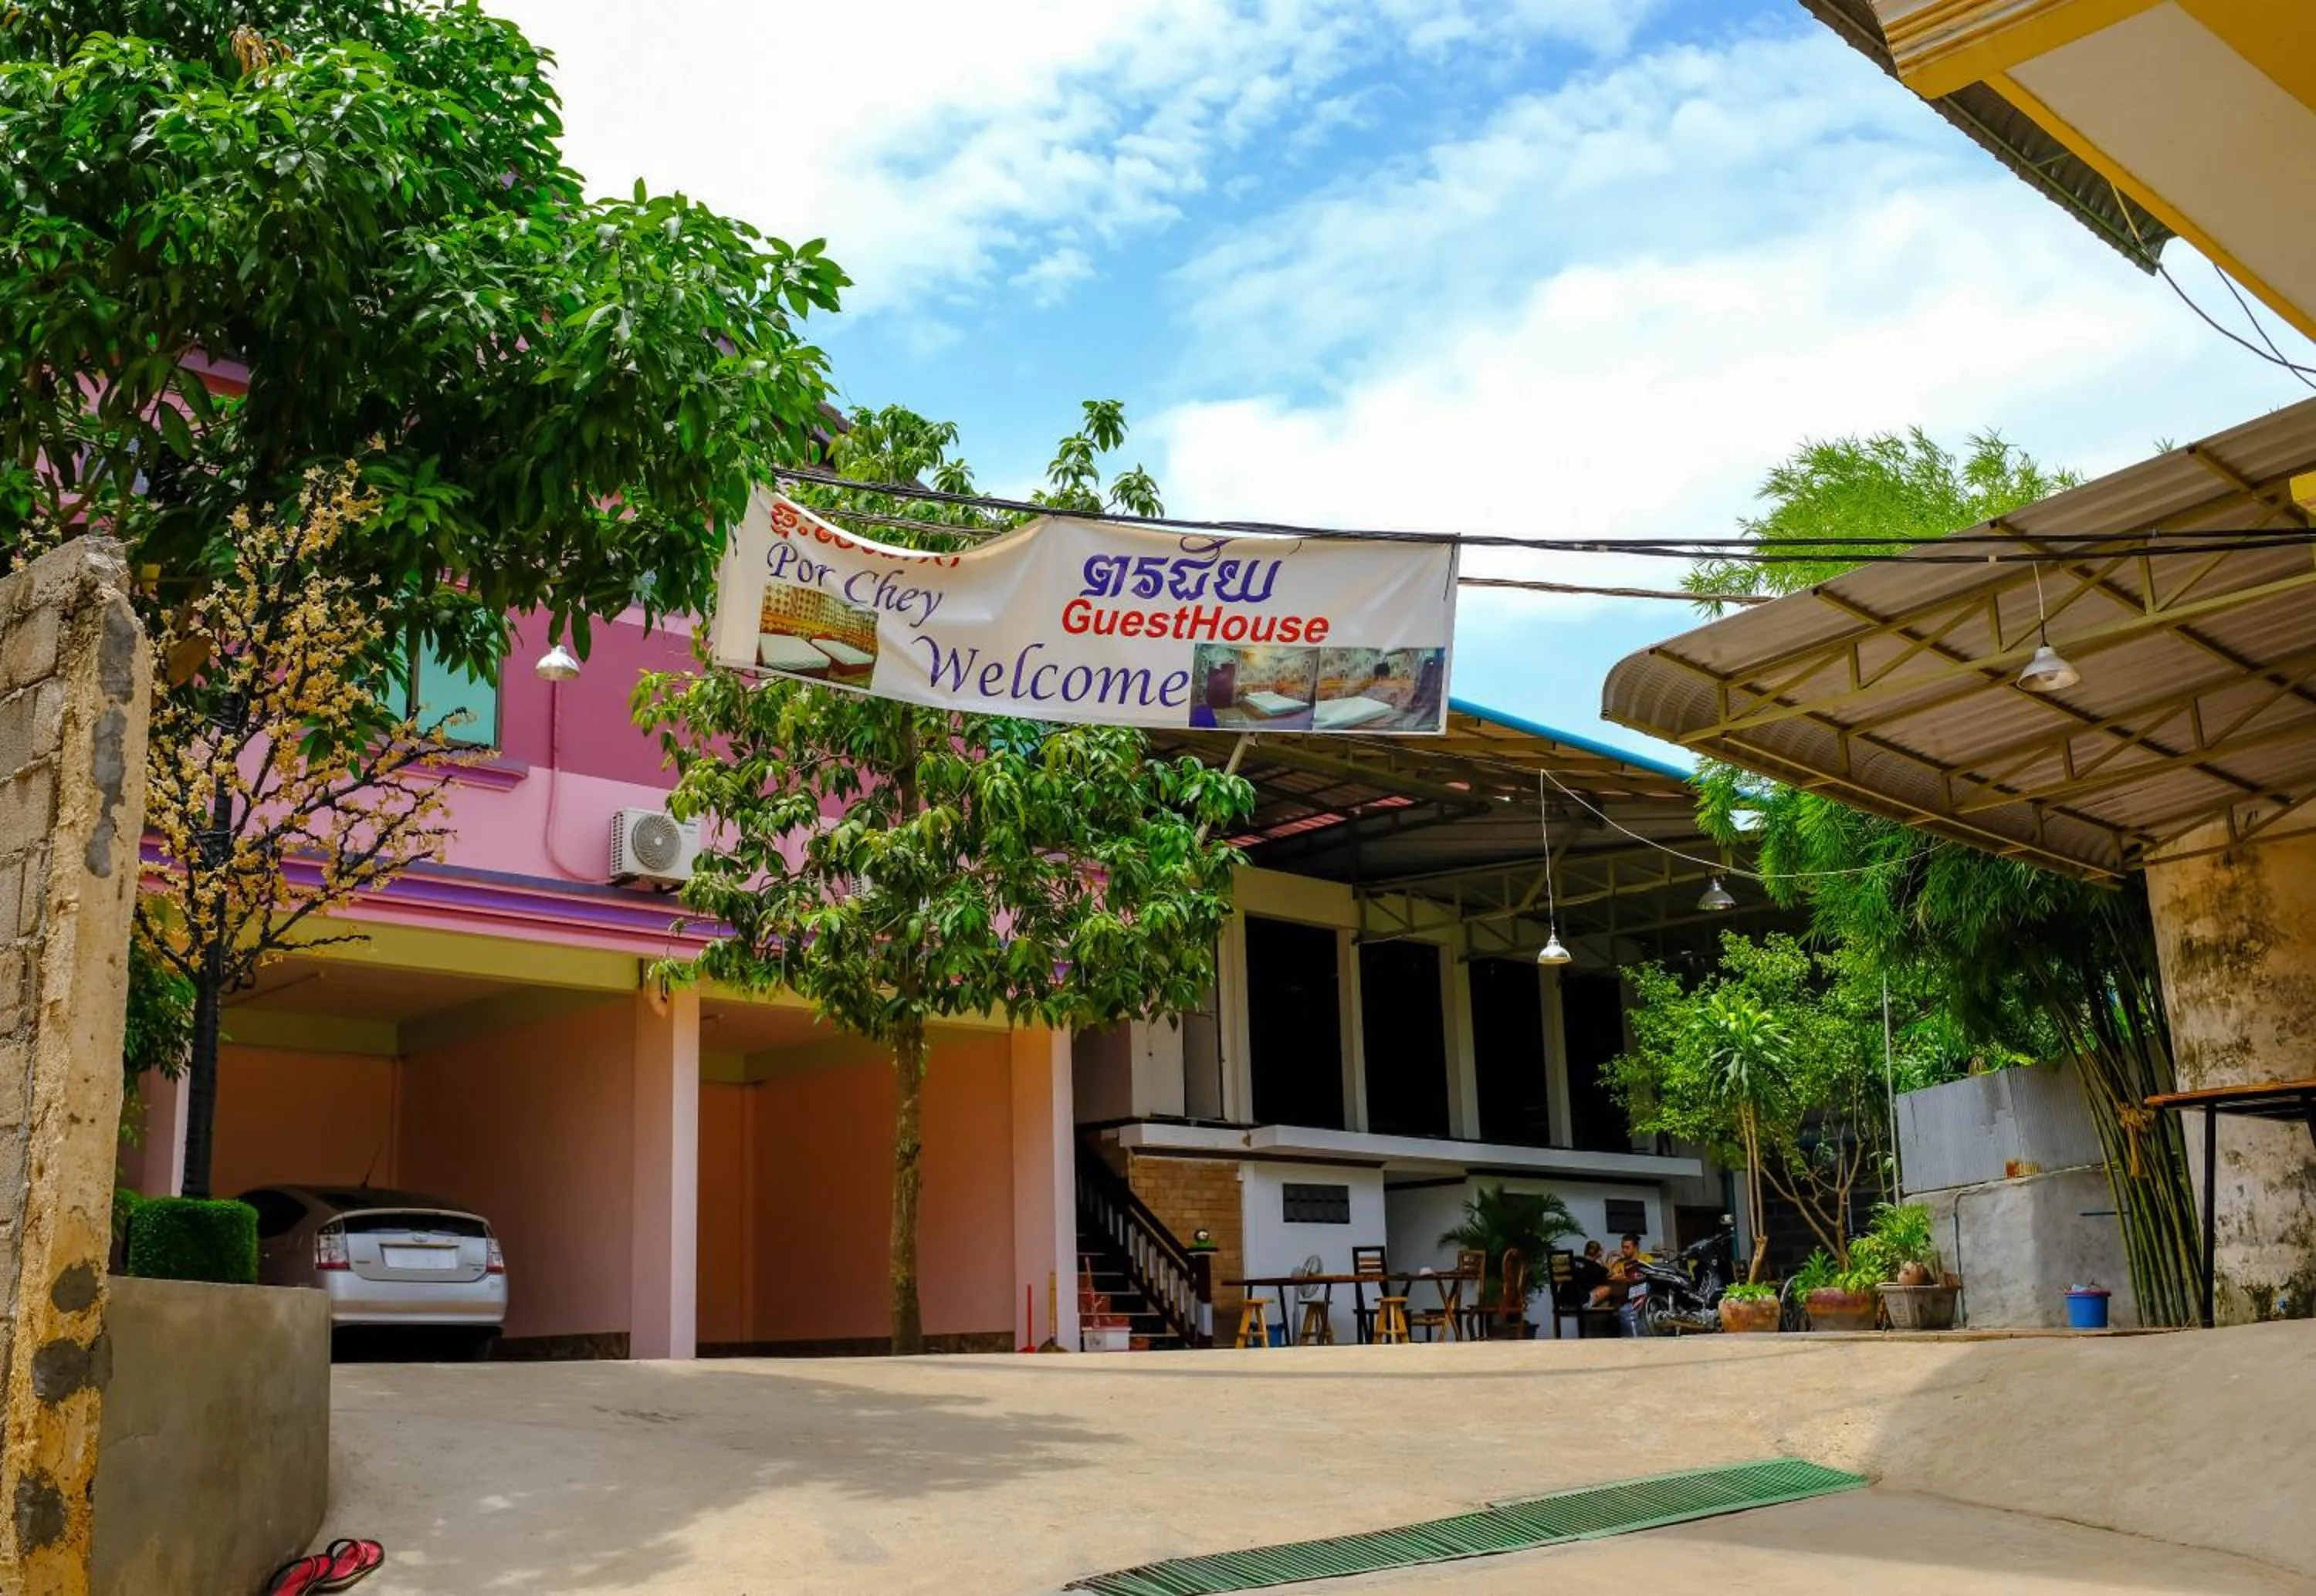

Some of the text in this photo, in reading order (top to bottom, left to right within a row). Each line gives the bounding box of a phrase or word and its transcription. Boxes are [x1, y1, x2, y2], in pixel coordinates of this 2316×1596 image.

[767, 541, 943, 628] Por Chey
[1062, 598, 1330, 644] GuestHouse
[911, 635, 1190, 708] Welcome
